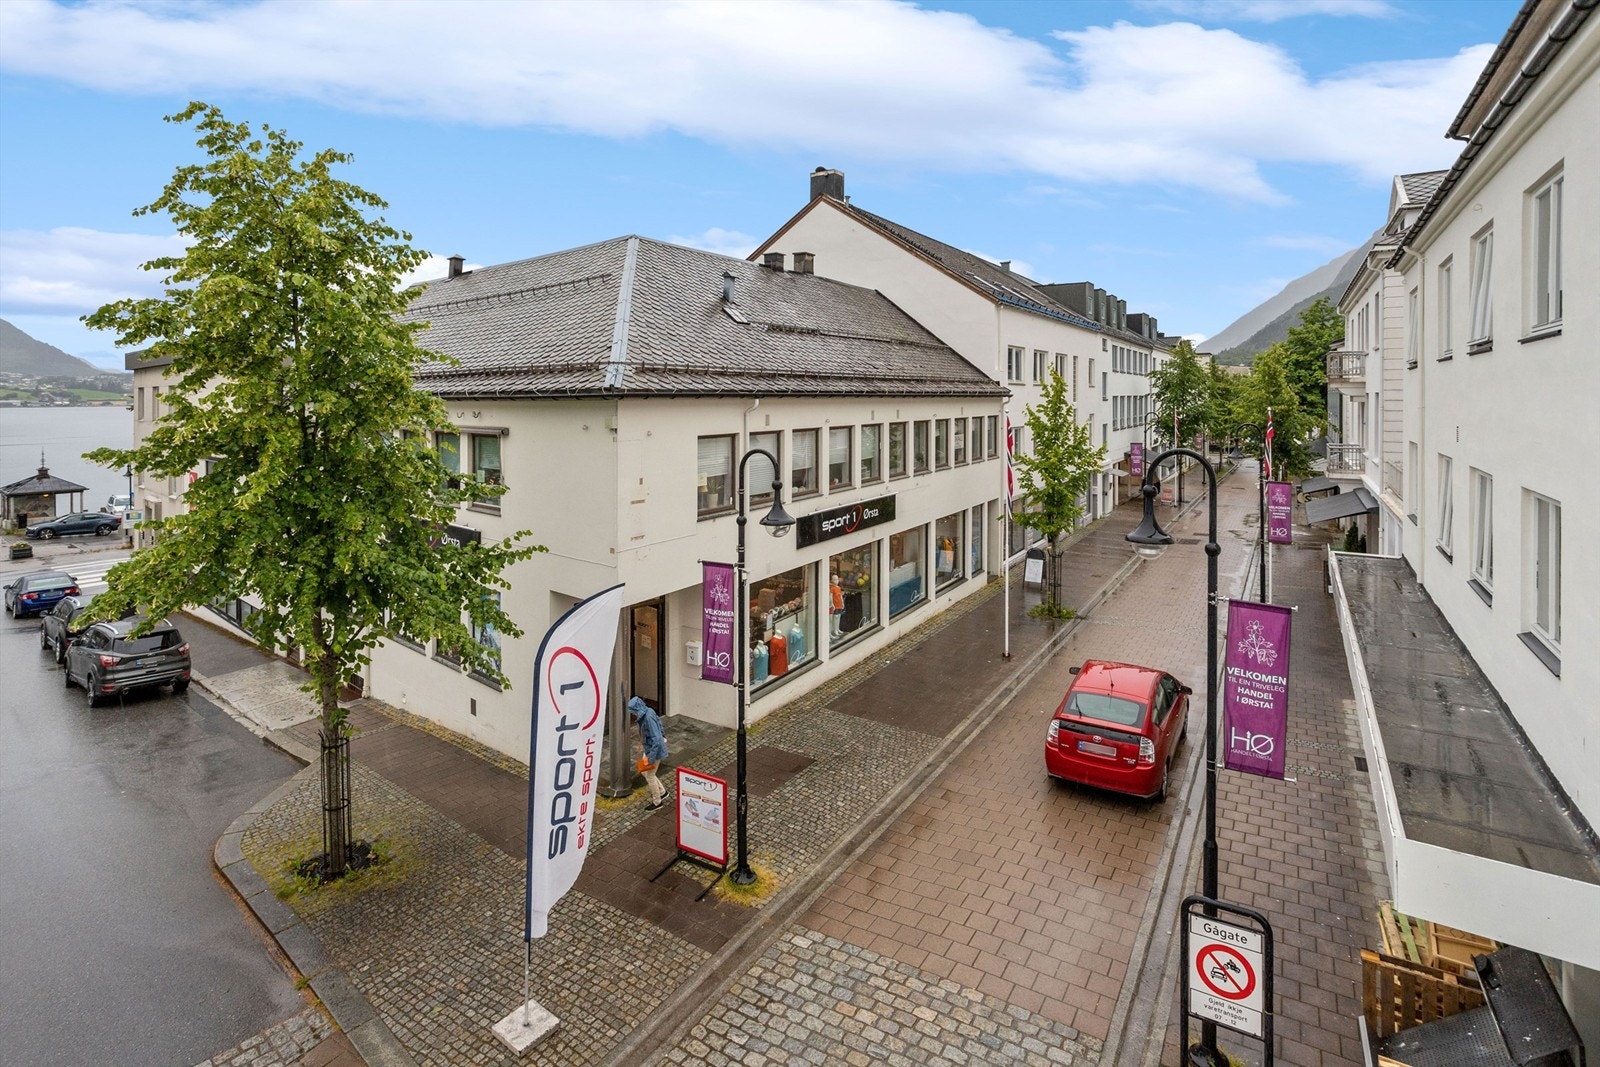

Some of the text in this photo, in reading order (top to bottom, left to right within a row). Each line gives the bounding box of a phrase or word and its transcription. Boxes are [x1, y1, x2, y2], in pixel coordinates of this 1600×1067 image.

[822, 508, 879, 532] sport 1 Ørsta
[1270, 527, 1288, 536] HØ
[707, 650, 730, 668] HØ
[1227, 666, 1287, 686] VELKOMEN
[1228, 676, 1285, 693] TIL EIN TRIVELEG
[1237, 686, 1274, 700] HANDEL
[1241, 697, 1273, 710] ØRSTA!
[1231, 727, 1274, 755] HØ
[548, 680, 584, 860] sport 1
[582, 738, 596, 796] sport
[685, 776, 707, 787] sport
[1203, 923, 1248, 944] Gågate
[1204, 1004, 1248, 1023] varetransport
[1208, 998, 1243, 1014] Gjeld ikkje
